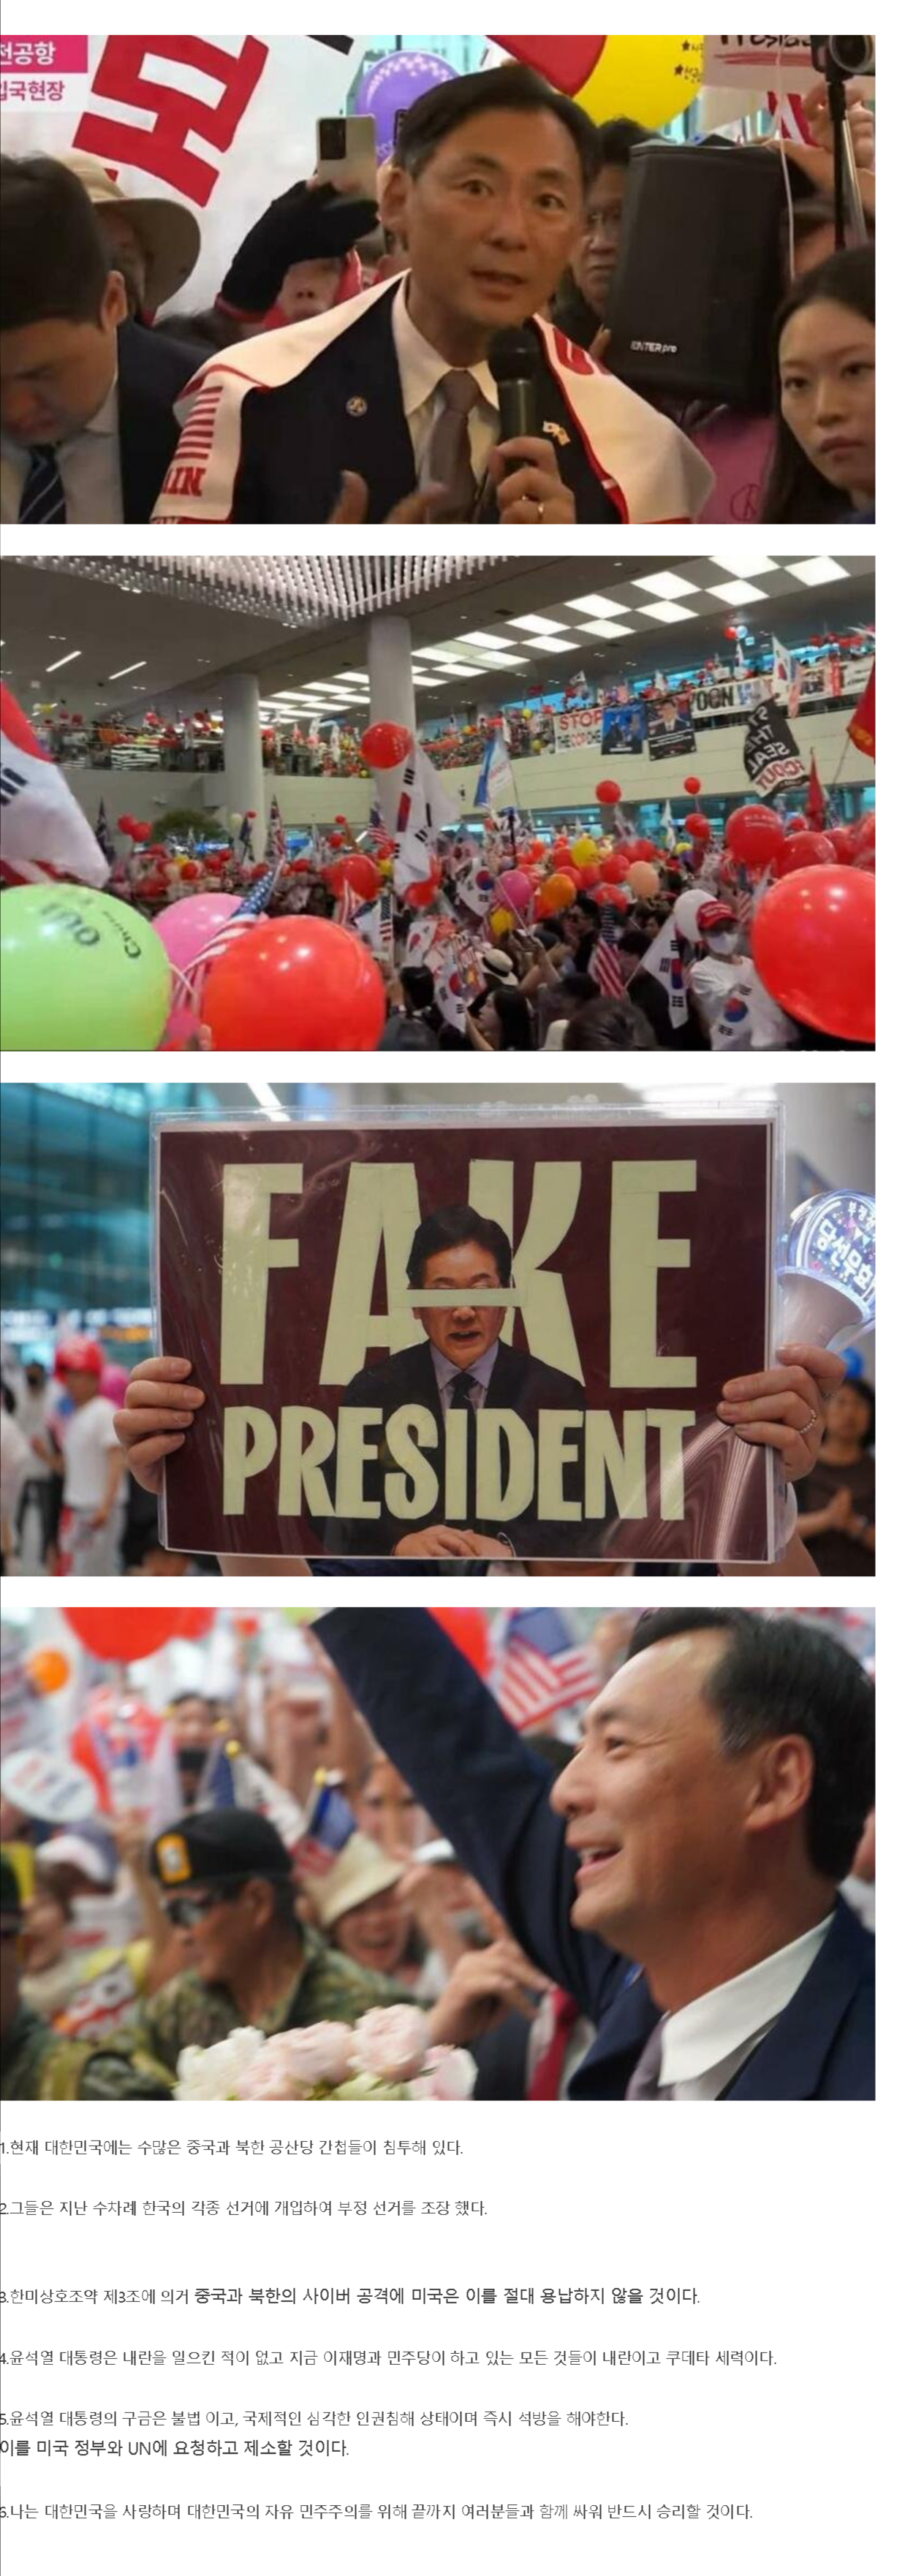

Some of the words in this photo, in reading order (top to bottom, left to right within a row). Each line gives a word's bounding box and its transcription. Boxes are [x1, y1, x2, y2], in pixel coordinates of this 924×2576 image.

[559, 710, 602, 730] STOP
[221, 1159, 697, 1388] FAKE
[223, 1404, 695, 1521] PRESIDENT
